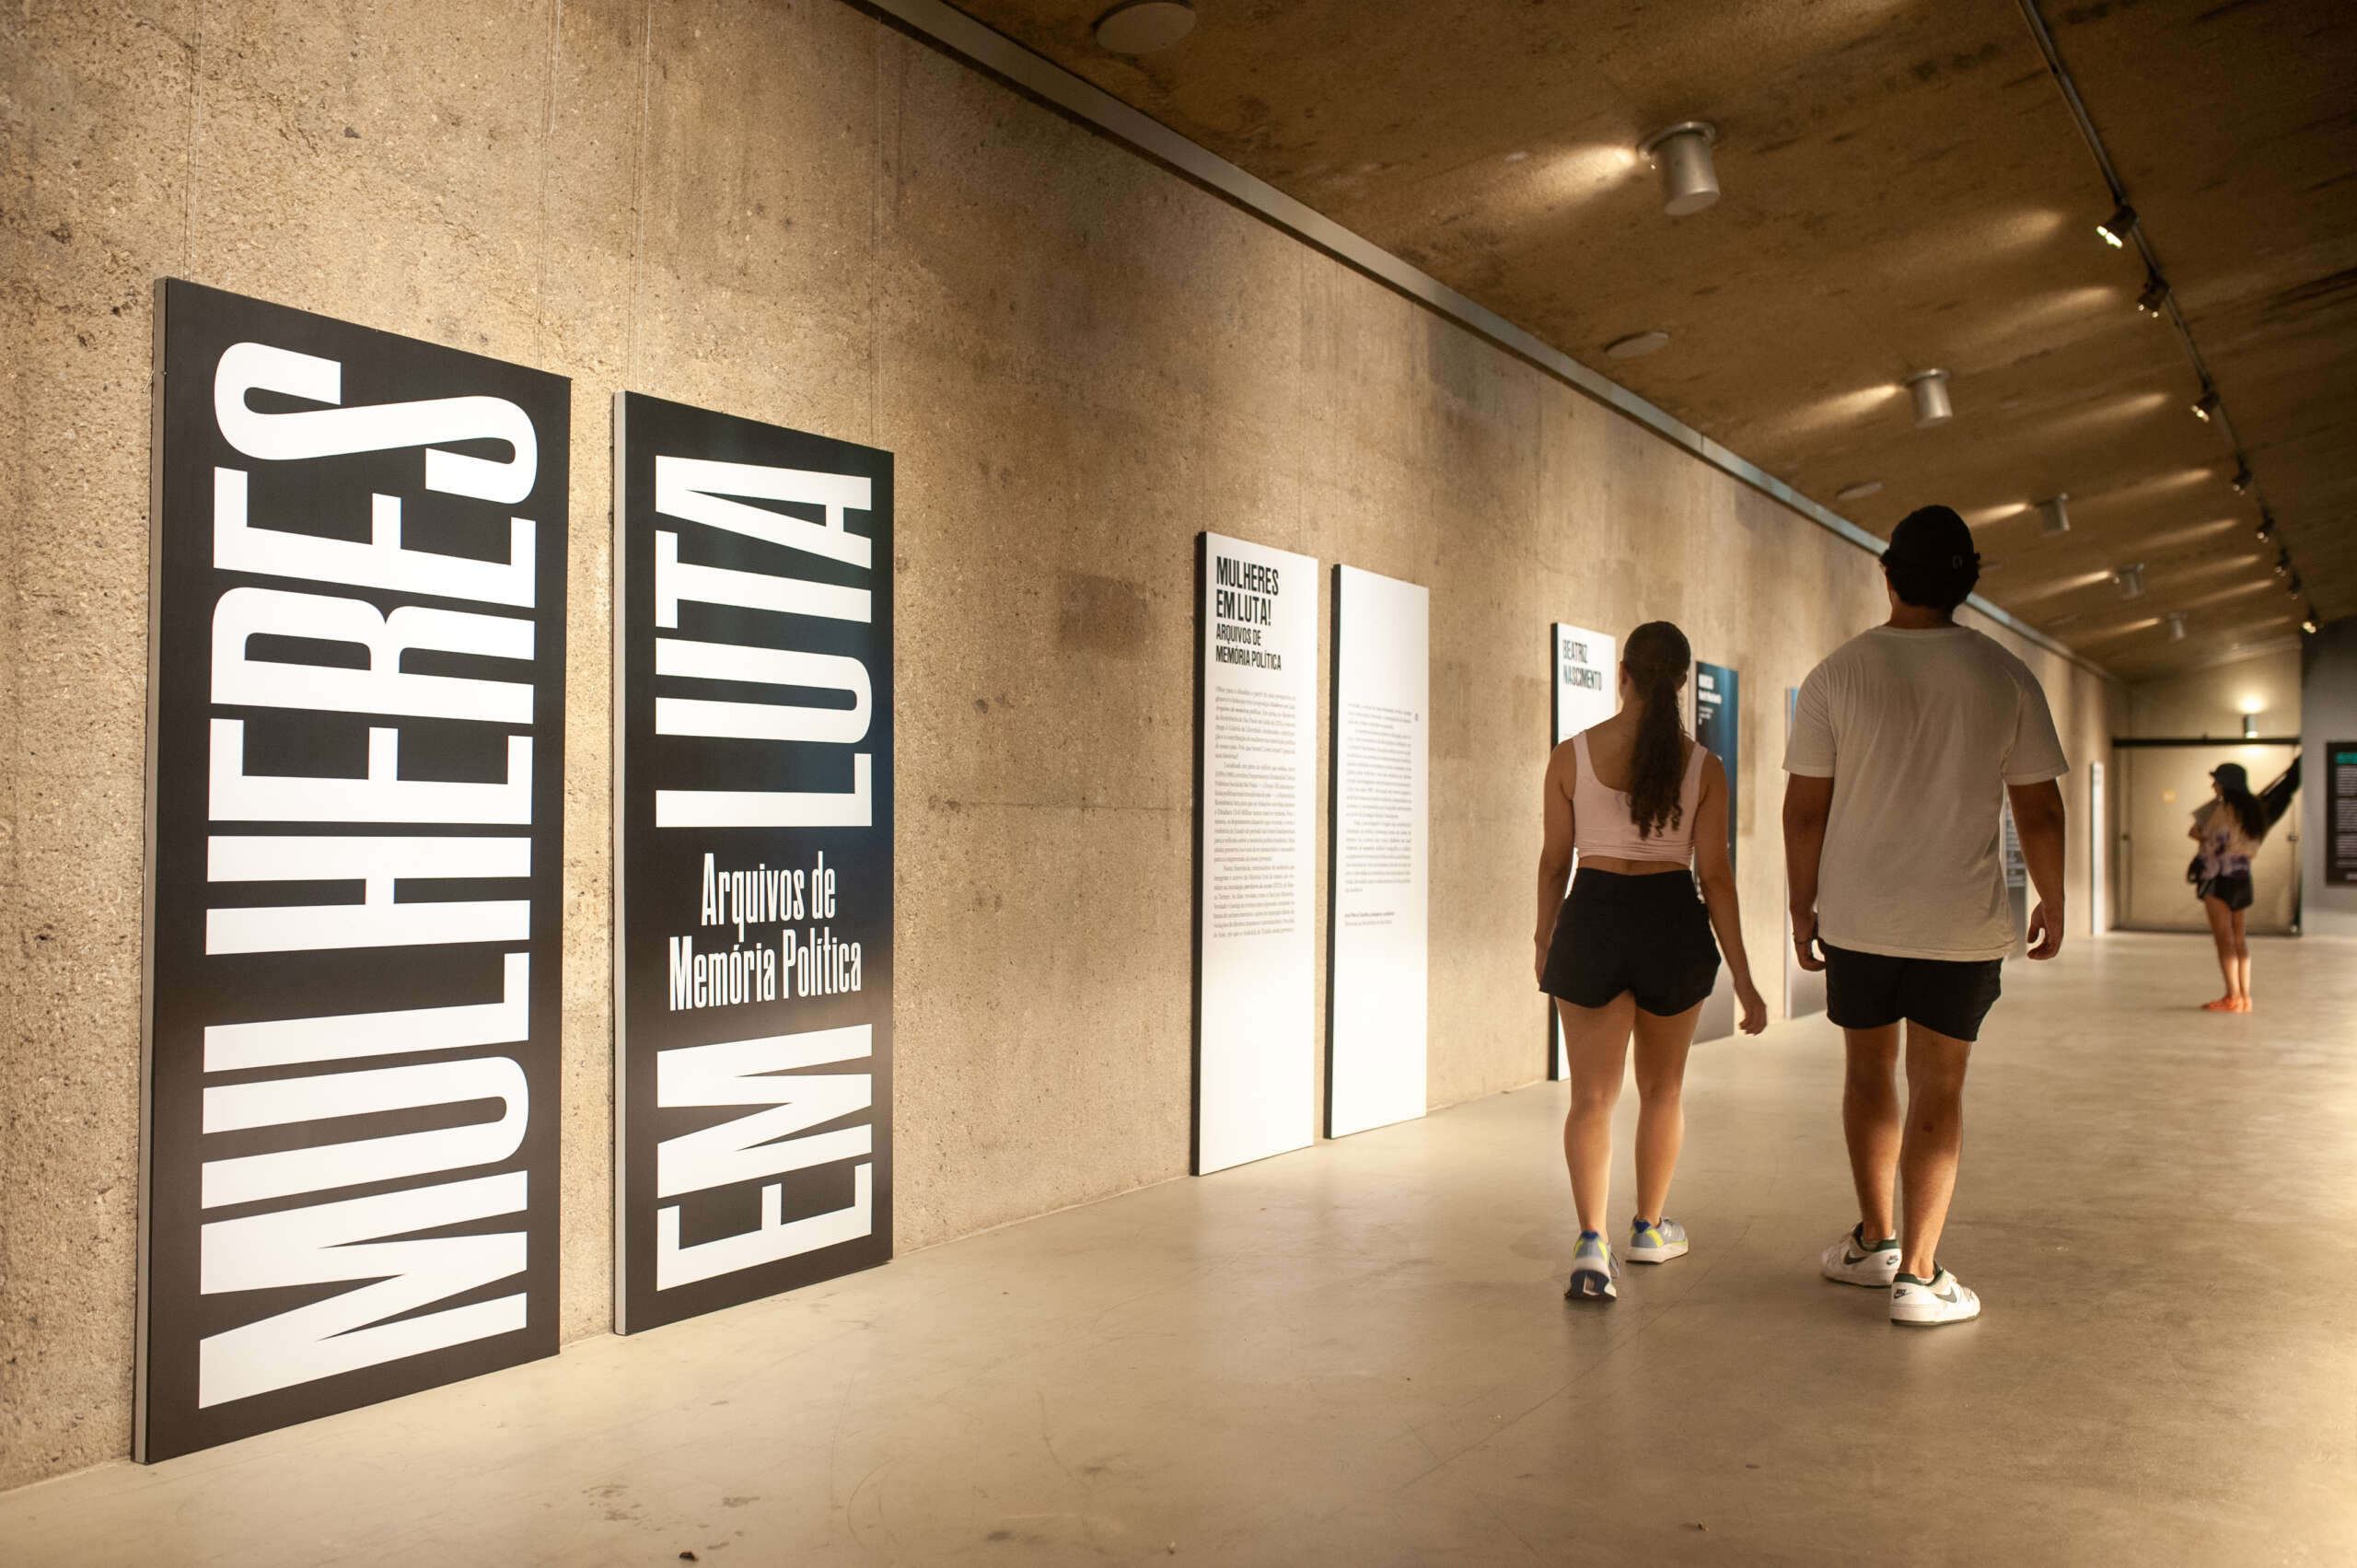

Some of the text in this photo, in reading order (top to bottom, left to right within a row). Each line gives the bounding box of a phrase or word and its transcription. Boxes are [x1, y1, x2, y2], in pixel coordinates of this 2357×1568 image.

[1216, 555, 1279, 596] MULHERES
[1216, 588, 1271, 626] EM LUTA!
[1216, 622, 1261, 646] ARQUIVOS DE
[1562, 639, 1587, 663] BEATRIZ
[1216, 644, 1282, 670] MEMÓRIA POLÍTICA
[1562, 663, 1602, 691] NASCIMENTO
[199, 343, 538, 1409] MULHERES
[656, 456, 872, 1291] EM LUTA
[702, 850, 836, 943] Arquivos de
[669, 926, 862, 1012] Memória Política
